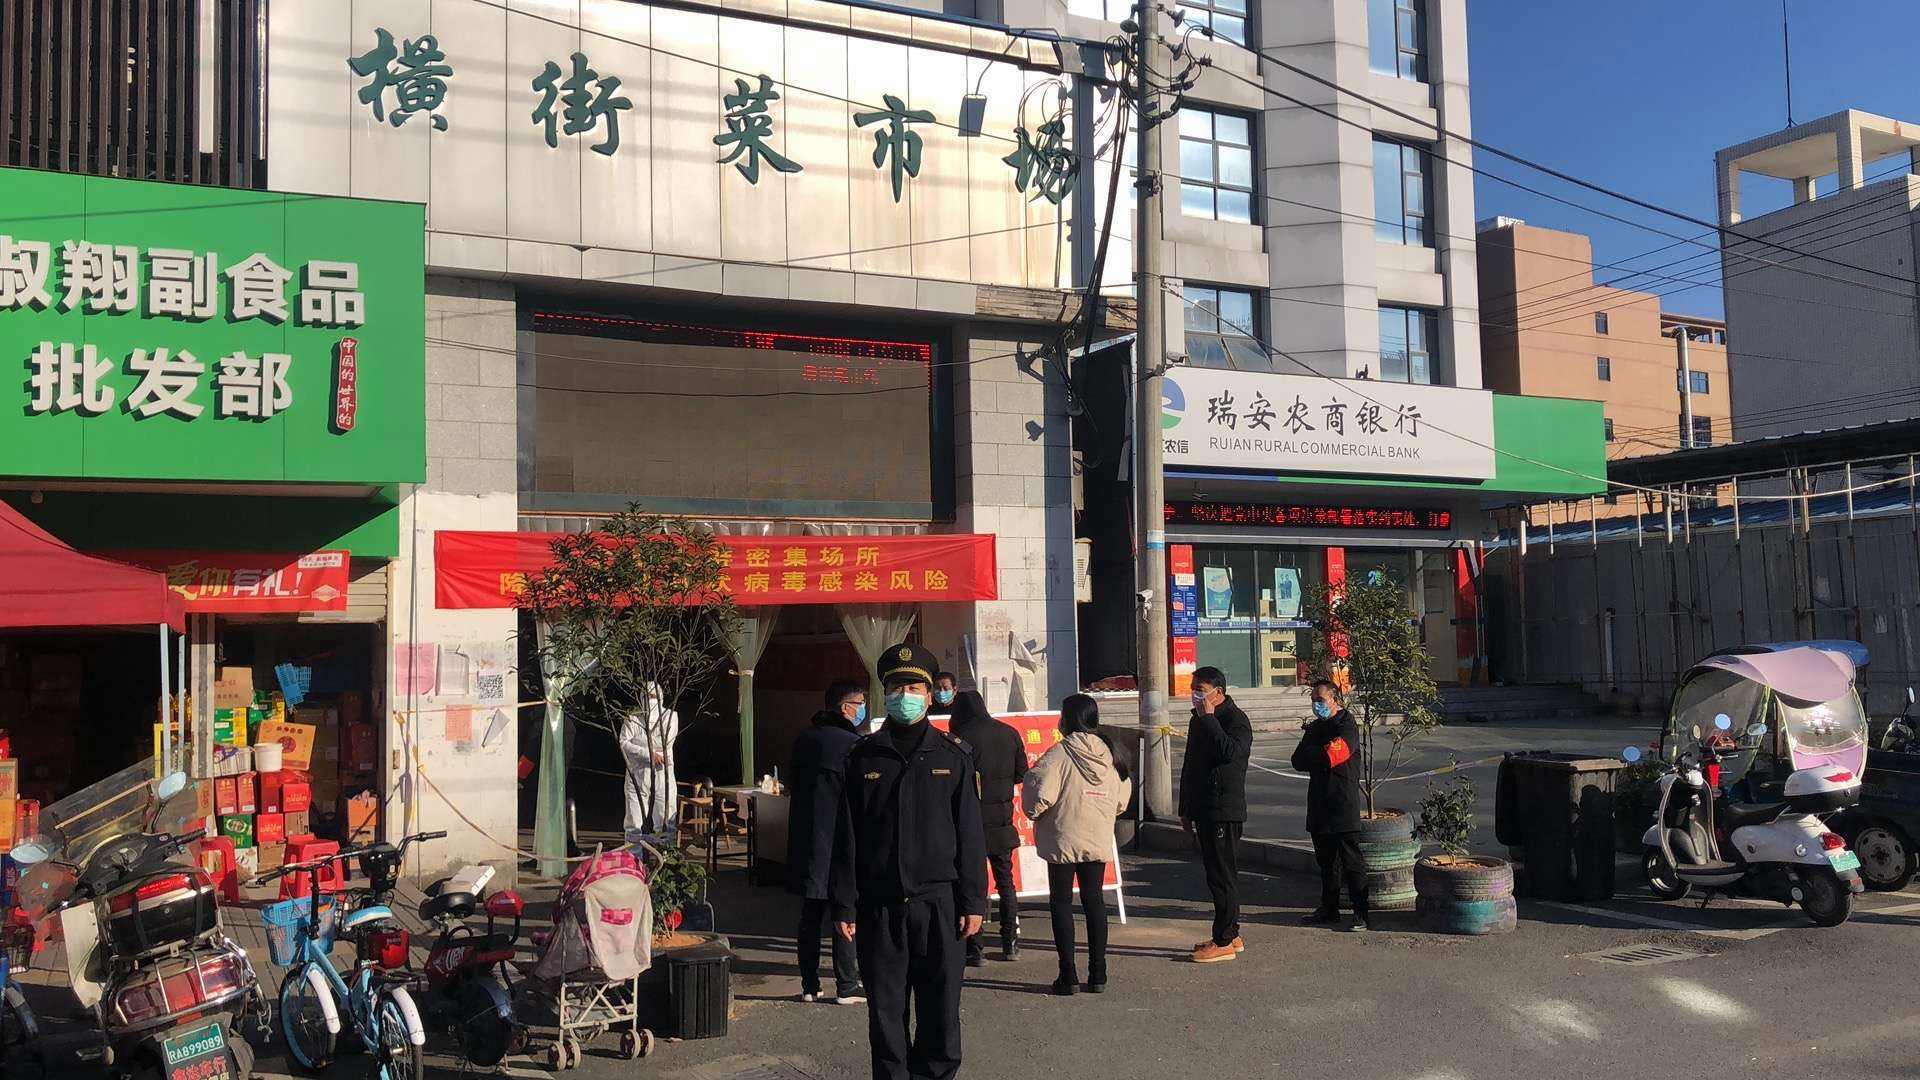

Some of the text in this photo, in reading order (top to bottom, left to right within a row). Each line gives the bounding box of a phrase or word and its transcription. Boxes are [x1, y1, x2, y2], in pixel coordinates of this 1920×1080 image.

[347, 27, 1080, 205] 横街菜市场
[30, 341, 293, 419] 批发部
[338, 338, 356, 426] 中国的世界的
[1207, 389, 1422, 438] 瑞安农商银行
[1162, 439, 1189, 454] 农信
[1209, 436, 1421, 459] RUIAN RURAL COMMERCIAL BANK
[169, 1035, 222, 1062] RA899089
